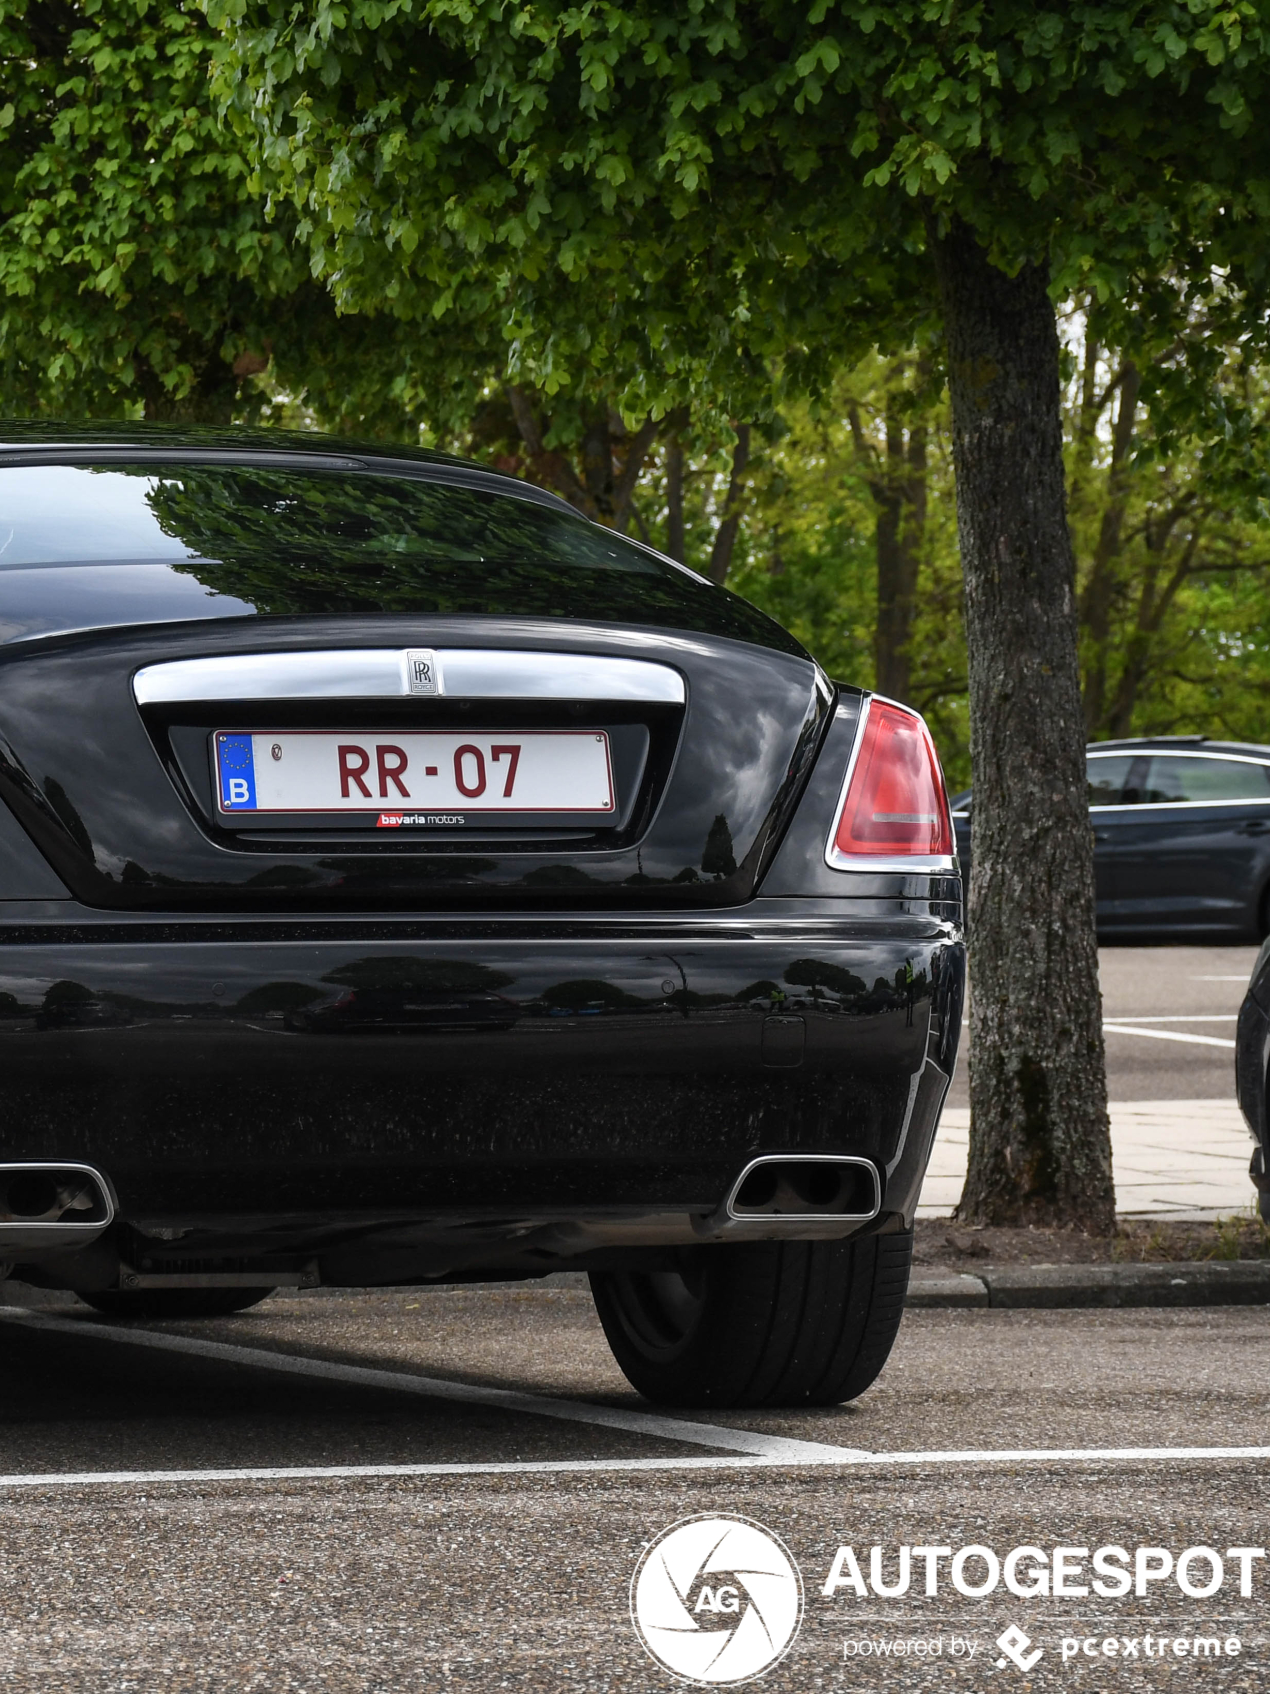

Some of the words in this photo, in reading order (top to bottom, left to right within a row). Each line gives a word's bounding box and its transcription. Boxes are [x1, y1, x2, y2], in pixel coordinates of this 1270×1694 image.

[229, 778, 250, 803] B
[381, 814, 426, 824] bavaria
[427, 814, 465, 824] motors
